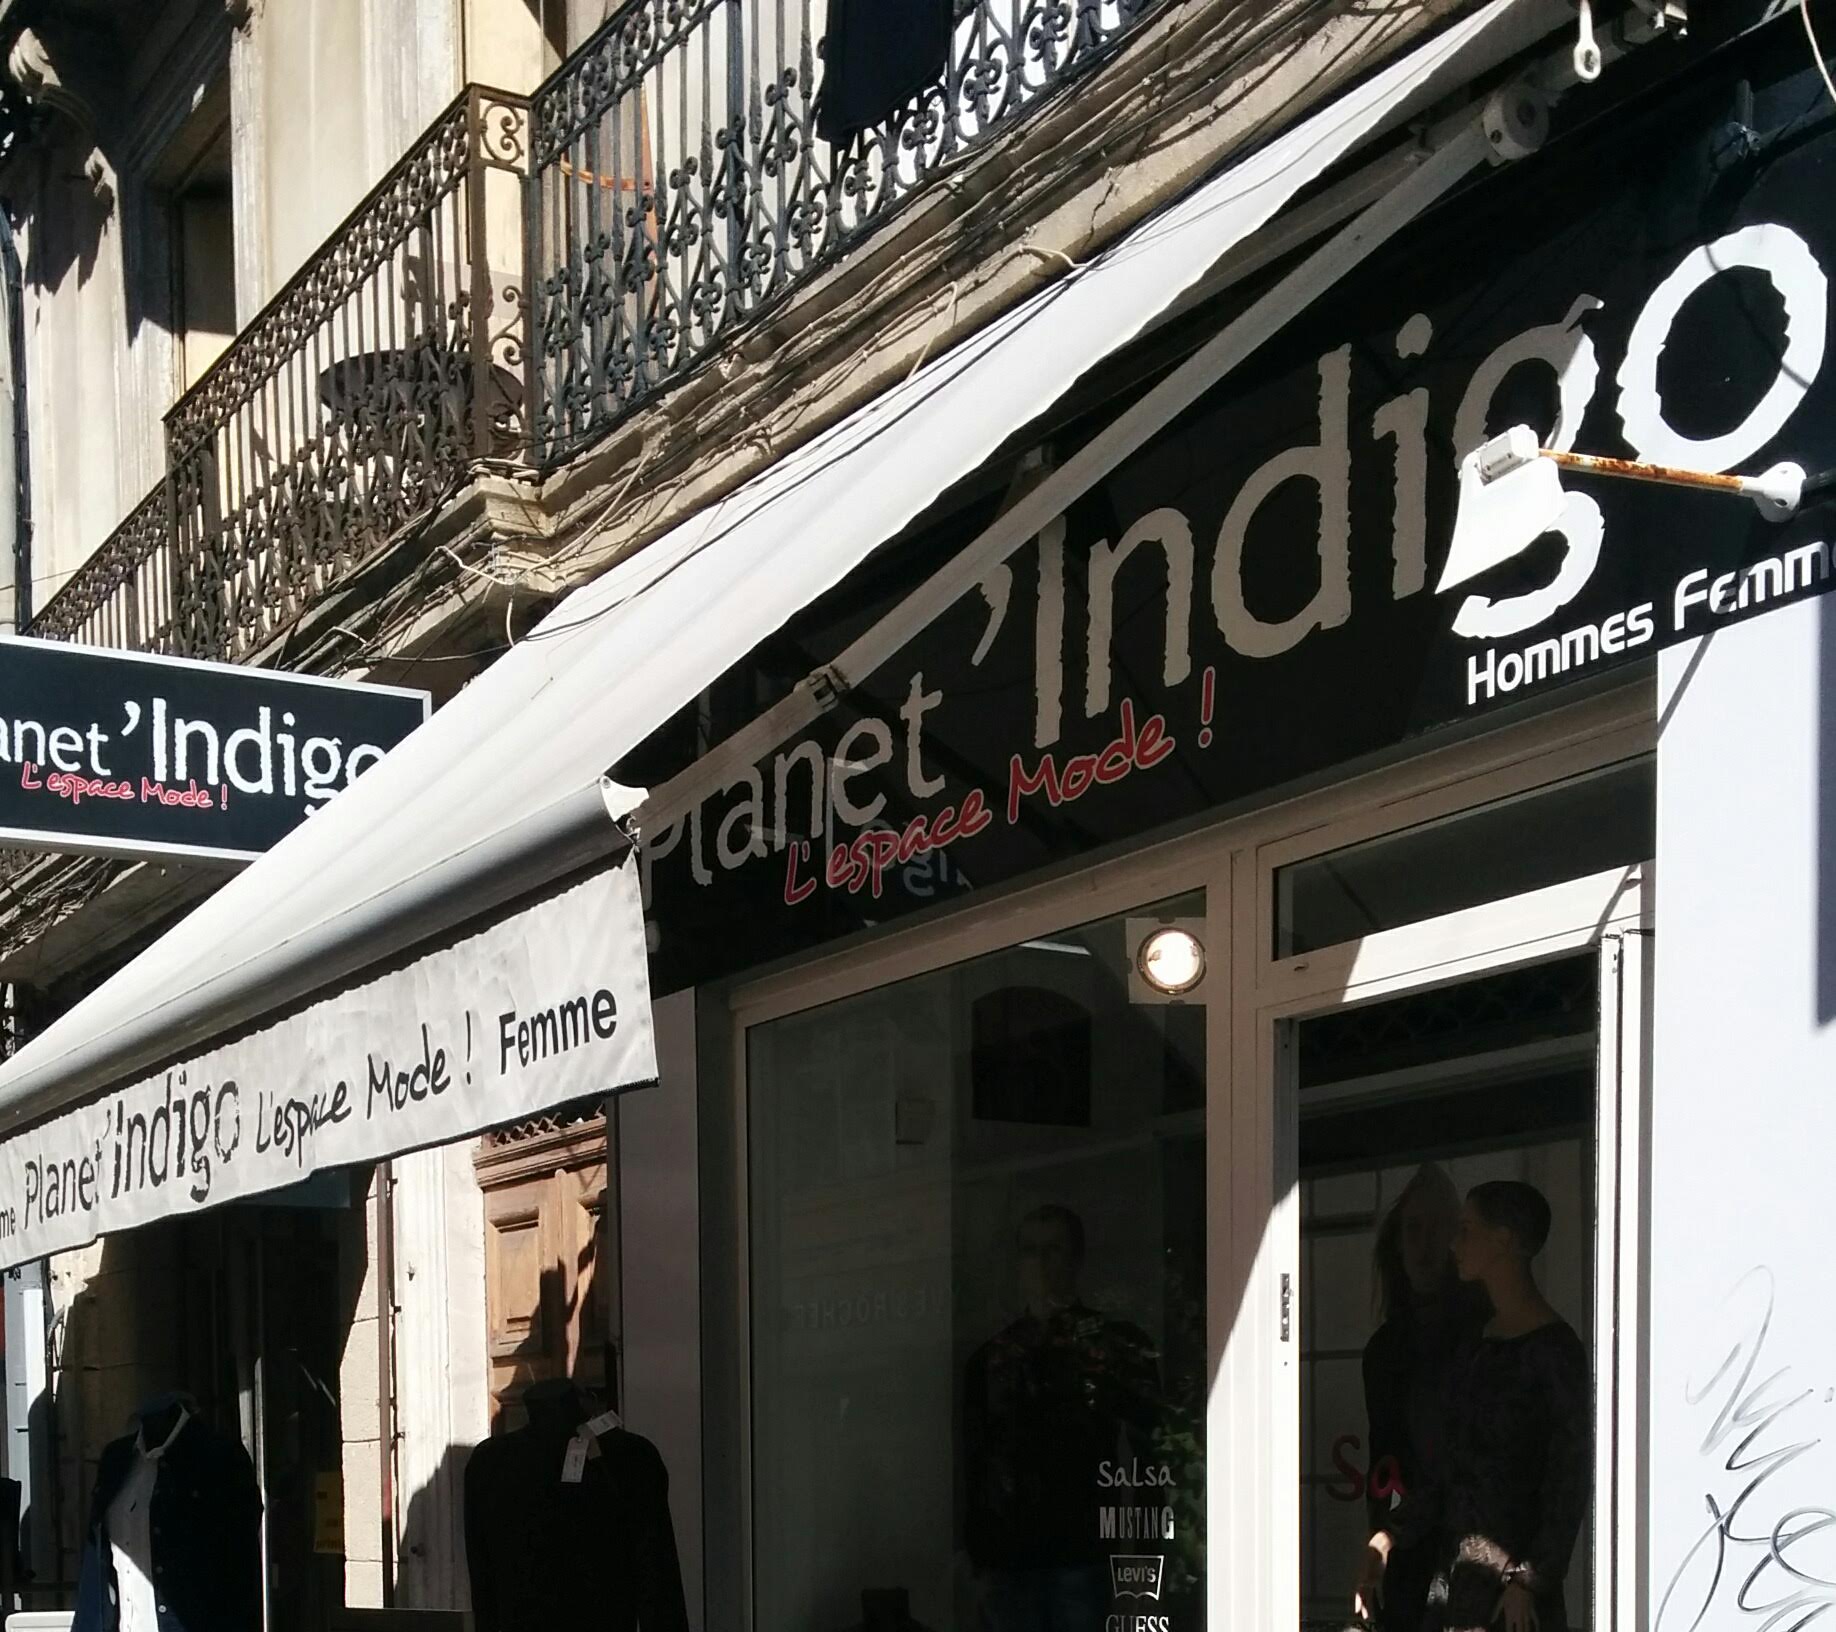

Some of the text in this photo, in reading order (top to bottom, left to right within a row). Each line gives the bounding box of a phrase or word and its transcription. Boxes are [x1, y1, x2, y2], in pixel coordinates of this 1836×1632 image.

[1674, 541, 1836, 631] Femm
[21, 761, 135, 805] L'espace
[141, 776, 214, 808] Mode
[784, 788, 993, 905] L'espace
[1007, 698, 1175, 825] Mode
[1197, 666, 1216, 749] !
[366, 1022, 451, 1120] Mode
[498, 988, 618, 1076] Femme
[1097, 1456, 1177, 1489] Salsa
[1099, 1505, 1175, 1541] MUSTANG
